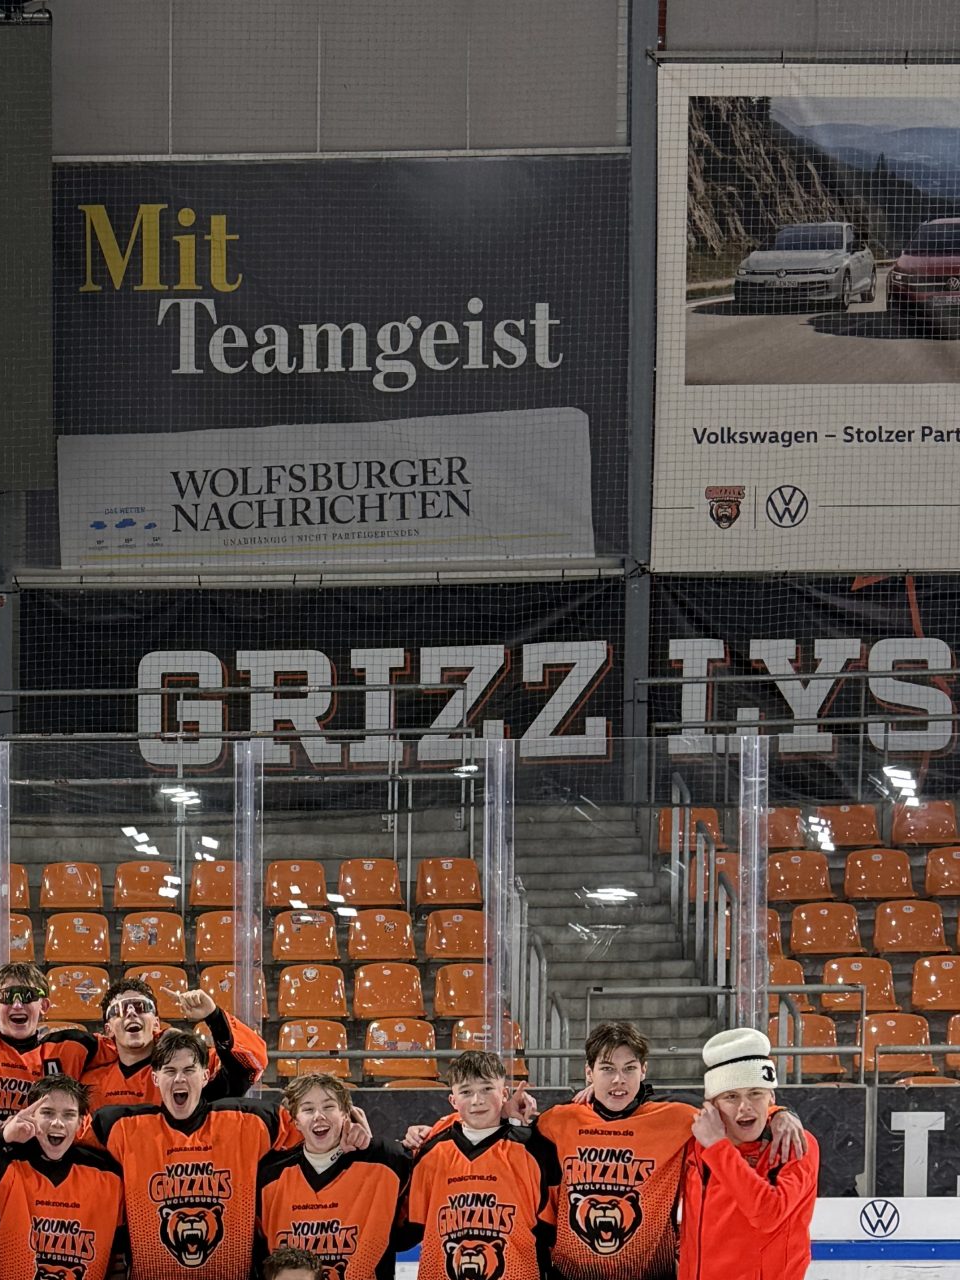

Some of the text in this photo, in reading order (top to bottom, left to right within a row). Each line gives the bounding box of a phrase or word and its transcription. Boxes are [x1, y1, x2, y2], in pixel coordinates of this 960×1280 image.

[78, 203, 243, 293] Mit
[157, 297, 564, 392] Teamgeist
[692, 426, 818, 448] Volkswagen
[842, 425, 915, 444] Stolzer
[920, 425, 960, 444] Part
[169, 456, 472, 500] WOLFSBURGER
[171, 489, 472, 533] NACHRICHTEN
[297, 533, 328, 543] NICHT
[0, 1077, 32, 1093] YOUN
[577, 1147, 634, 1163] YOUNG
[165, 1162, 214, 1178] YOUNG
[563, 1157, 655, 1187] GRIZZLYS
[149, 1170, 232, 1202] GRIZZLYS
[35, 1199, 81, 1209] peakzone.de
[166, 1196, 218, 1205] WOLFSBURG
[447, 1193, 497, 1209] YOUNG
[32, 1216, 81, 1235] YOUNG
[291, 1219, 340, 1236] YOUNG
[438, 1204, 516, 1237] GRIZZLYS
[31, 1230, 96, 1261] RIZZLYS
